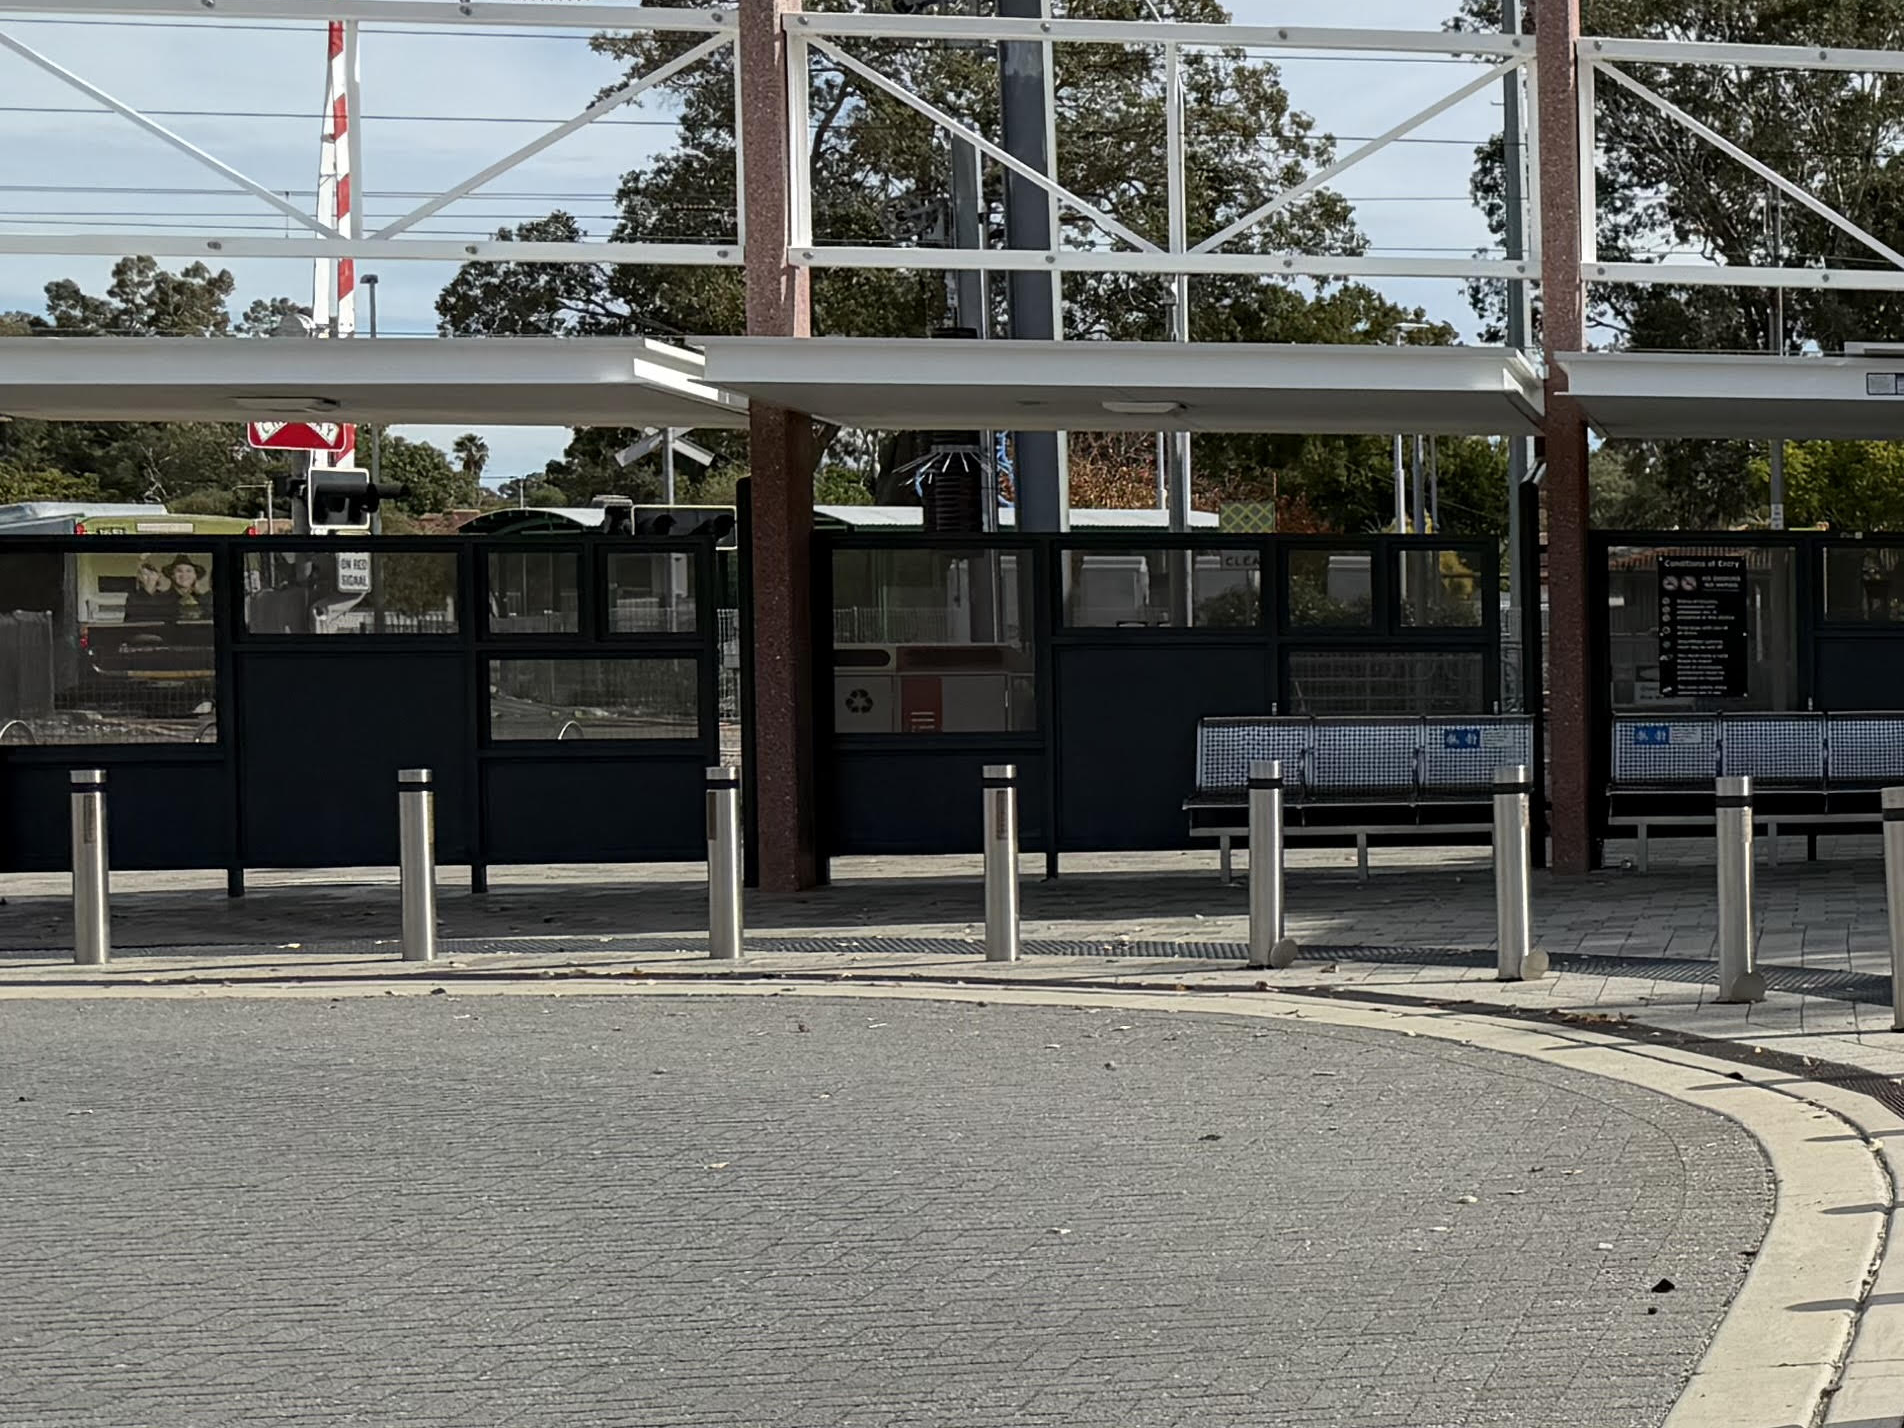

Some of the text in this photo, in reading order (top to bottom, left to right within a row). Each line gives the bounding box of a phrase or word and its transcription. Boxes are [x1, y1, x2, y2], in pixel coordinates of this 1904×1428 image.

[353, 559, 367, 570] RED
[1664, 559, 1706, 568] Conditions
[1717, 560, 1739, 569] Entry
